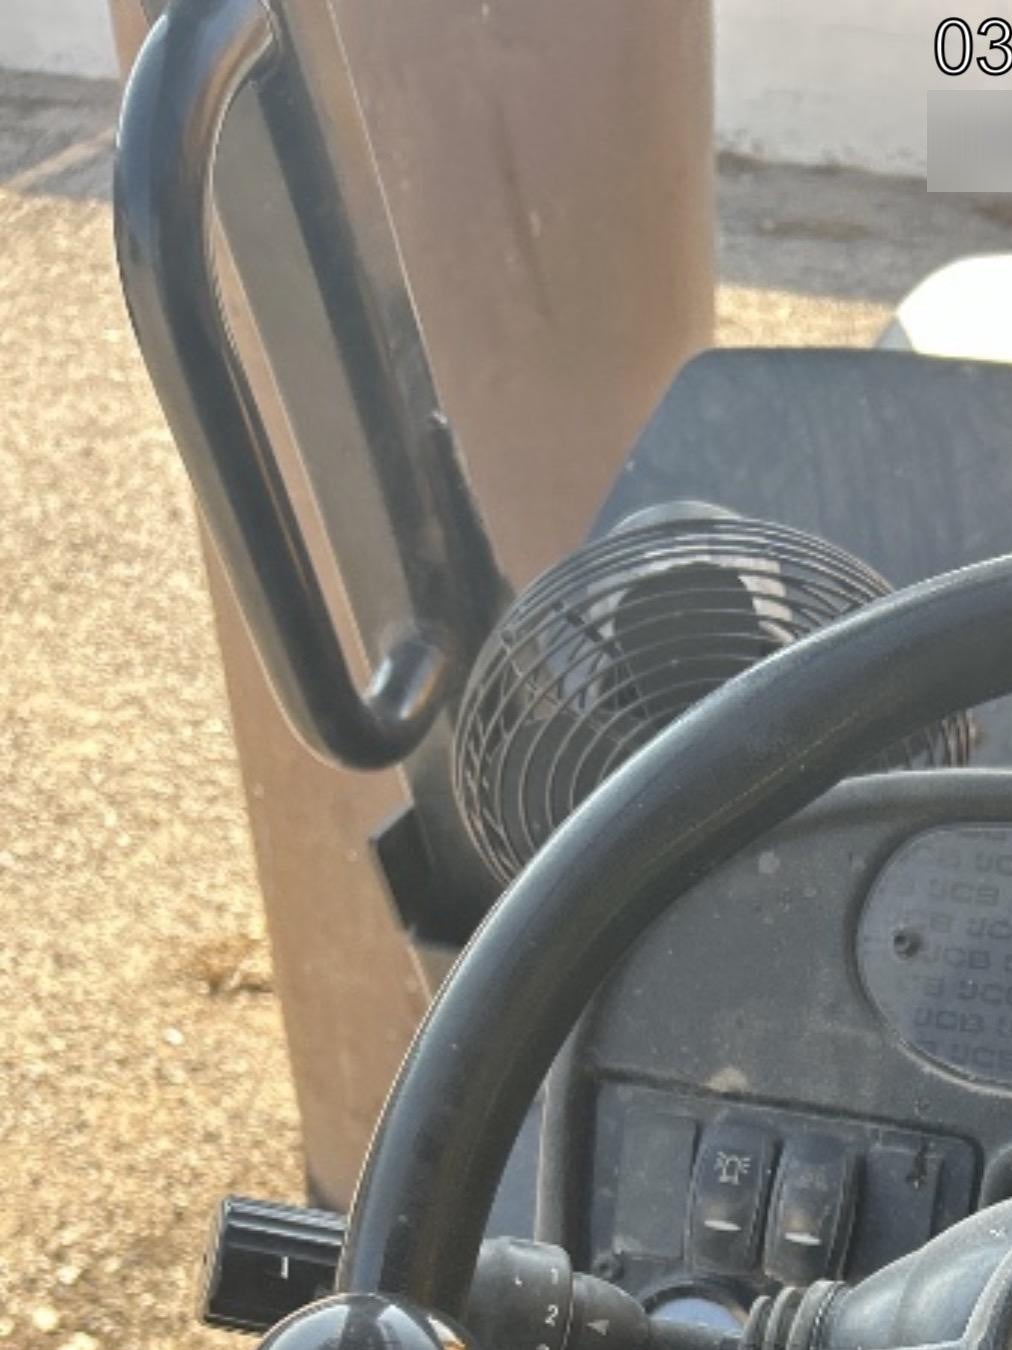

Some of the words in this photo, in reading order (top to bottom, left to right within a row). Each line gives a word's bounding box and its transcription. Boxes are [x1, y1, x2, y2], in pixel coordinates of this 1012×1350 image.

[929, 878, 999, 906] JCB
[914, 1007, 984, 1033] JCB
[545, 1304, 559, 1326] 2
